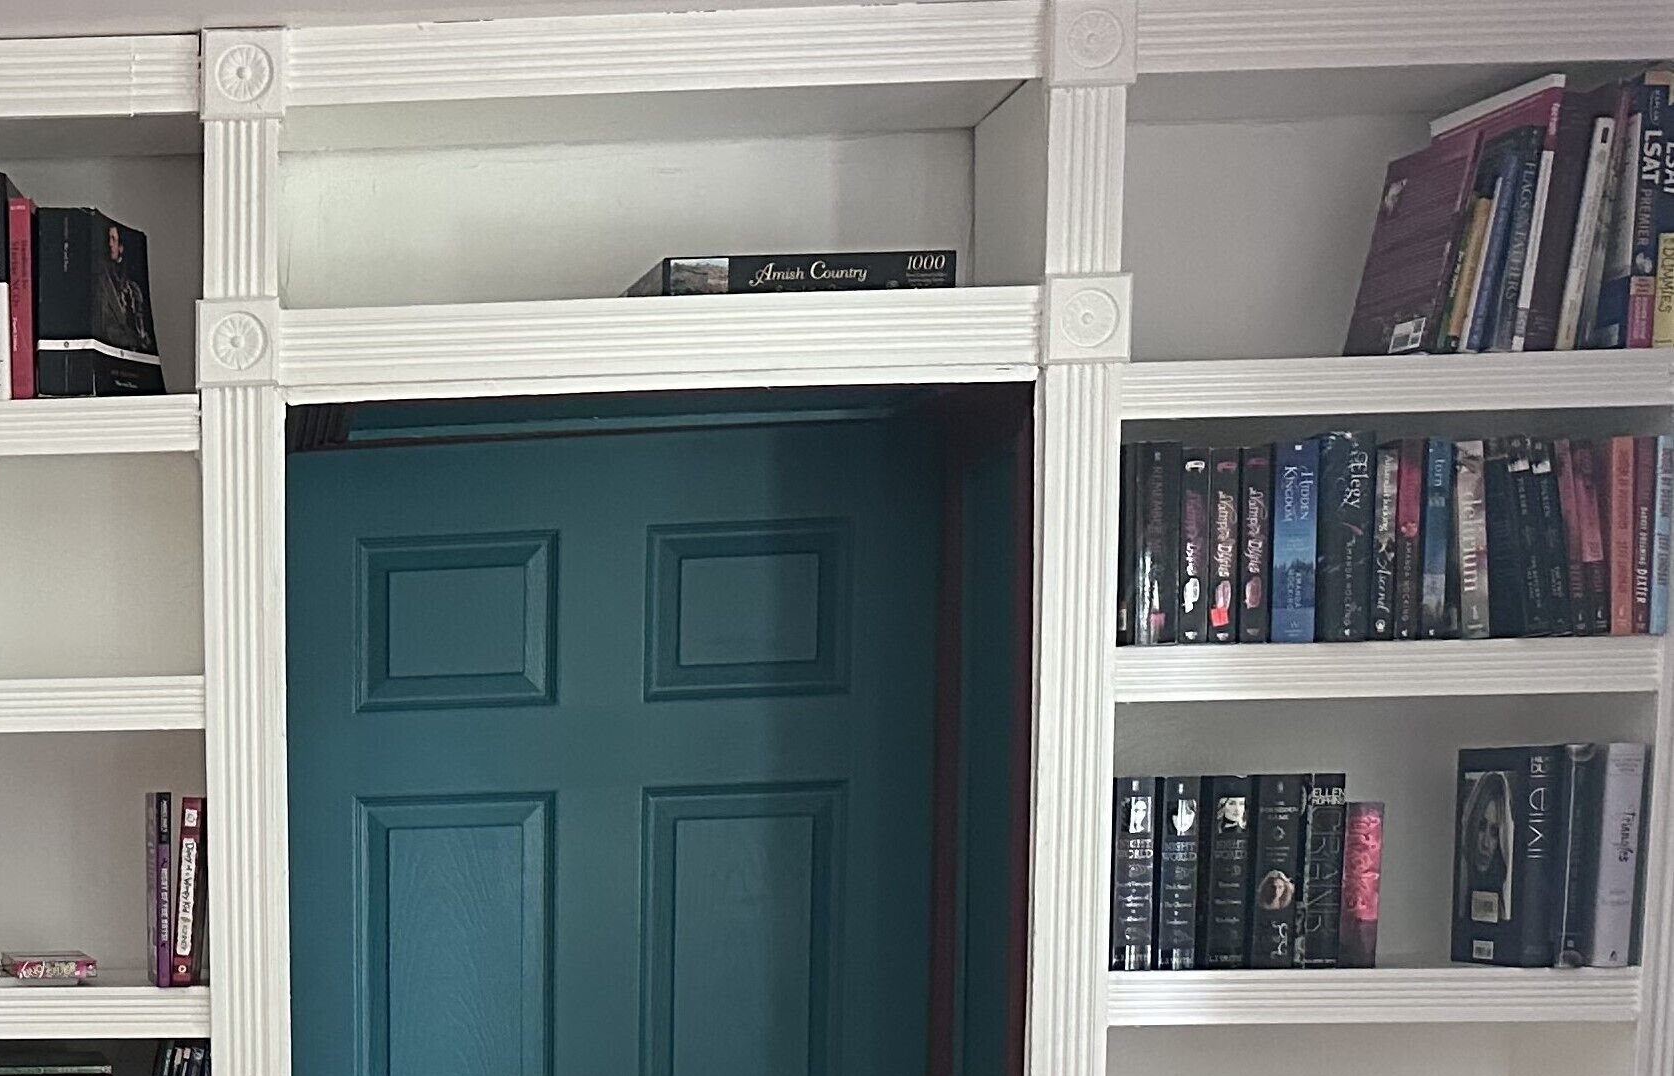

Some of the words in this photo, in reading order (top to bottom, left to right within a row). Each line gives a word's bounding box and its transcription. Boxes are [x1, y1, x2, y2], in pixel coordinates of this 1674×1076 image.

[1642, 129, 1663, 185] LSAT
[1519, 162, 1537, 209] FLAGS
[1635, 188, 1652, 247] PREMIER
[750, 262, 805, 286] Amish
[810, 261, 869, 282] Country
[907, 254, 947, 271] 1000
[1284, 465, 1297, 522] KINGDOM
[1300, 465, 1314, 521] HIDDEN
[1343, 450, 1369, 510] Elegy
[1433, 458, 1446, 488] torn
[1312, 788, 1346, 797] ELLEN
[1162, 851, 1197, 861] WORLD
[1165, 841, 1196, 851] NIGHT
[1619, 810, 1637, 863] Triangles
[1305, 806, 1344, 933] CRANK
